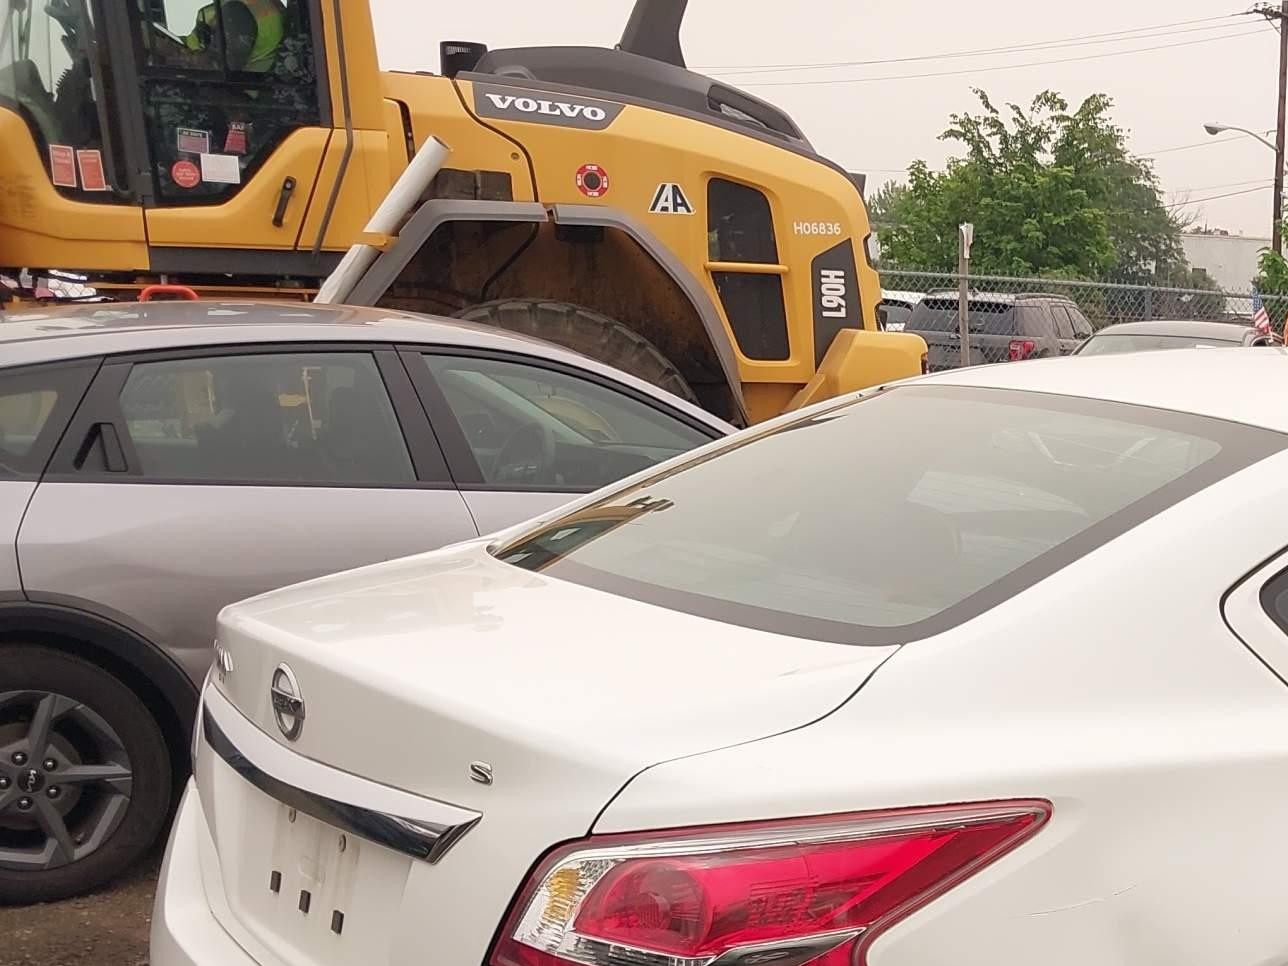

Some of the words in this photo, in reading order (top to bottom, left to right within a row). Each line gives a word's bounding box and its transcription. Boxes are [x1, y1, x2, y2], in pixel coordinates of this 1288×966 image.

[485, 93, 606, 121] VOLVO
[793, 222, 841, 235] H06836
[820, 269, 847, 318] L90H
[470, 760, 493, 786] S
